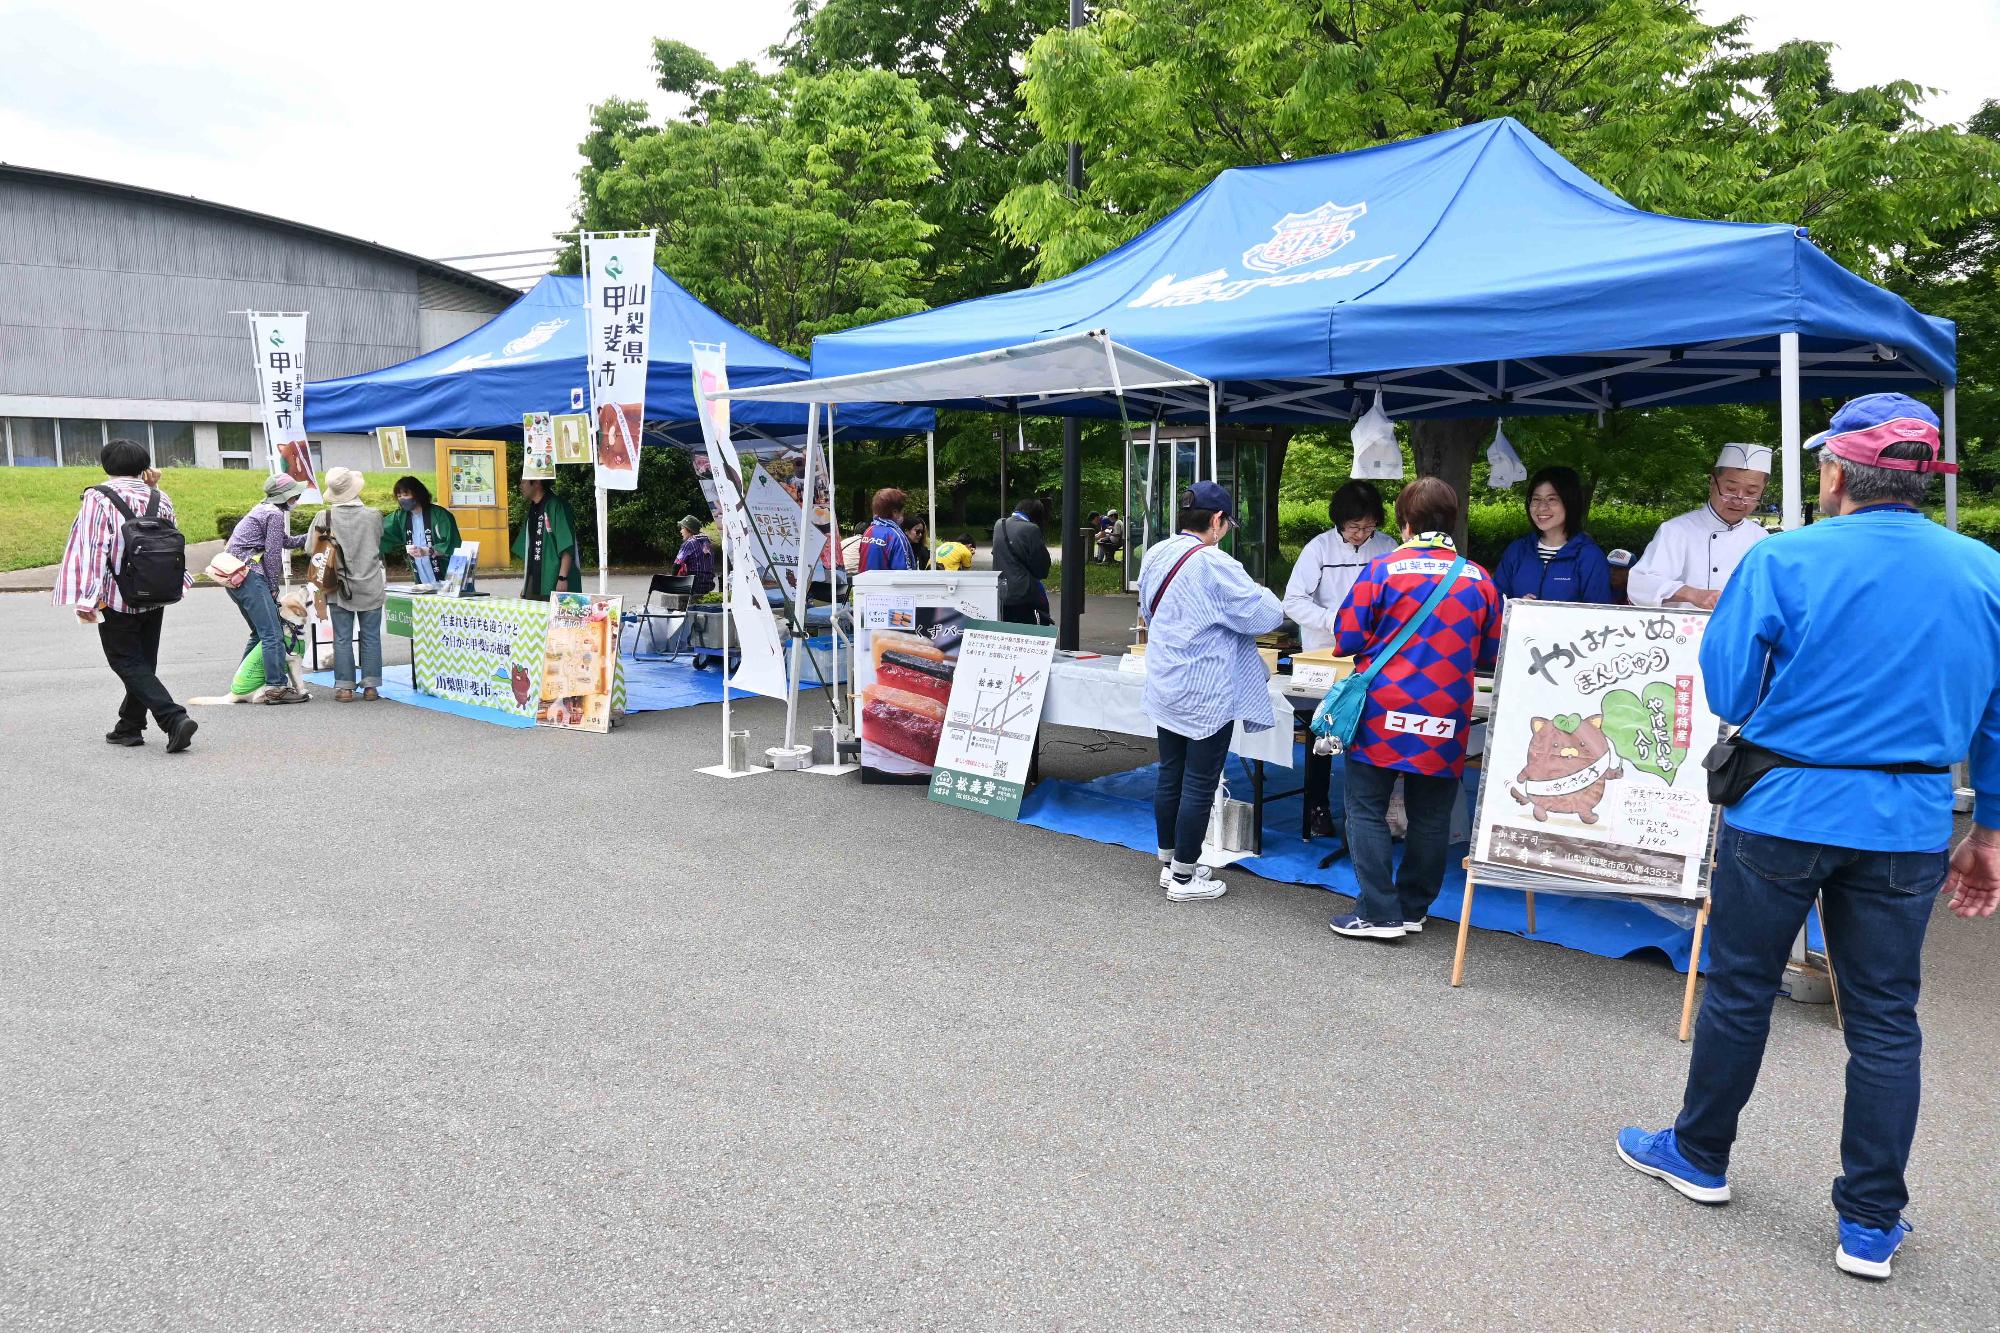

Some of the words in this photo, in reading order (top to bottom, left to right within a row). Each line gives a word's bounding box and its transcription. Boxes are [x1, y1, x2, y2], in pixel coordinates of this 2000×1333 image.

[598, 286, 625, 387] 甲斐市
[623, 283, 646, 364] 山梨県
[270, 352, 292, 429] 甲斐市
[440, 613, 519, 636] 生まれも育ちも違うけど
[1528, 615, 1675, 686] やはたいぬ
[1576, 648, 1667, 692] まんじゅう
[1391, 714, 1451, 735] コイケ
[1676, 679, 1691, 742] 甲斐市特産
[1634, 729, 1653, 760] 入り
[1646, 697, 1673, 772] やはたいも
[955, 776, 997, 798] 松寿堂
[1494, 842, 1556, 868] 松寿堂
[1498, 830, 1539, 845] 御菓子司
